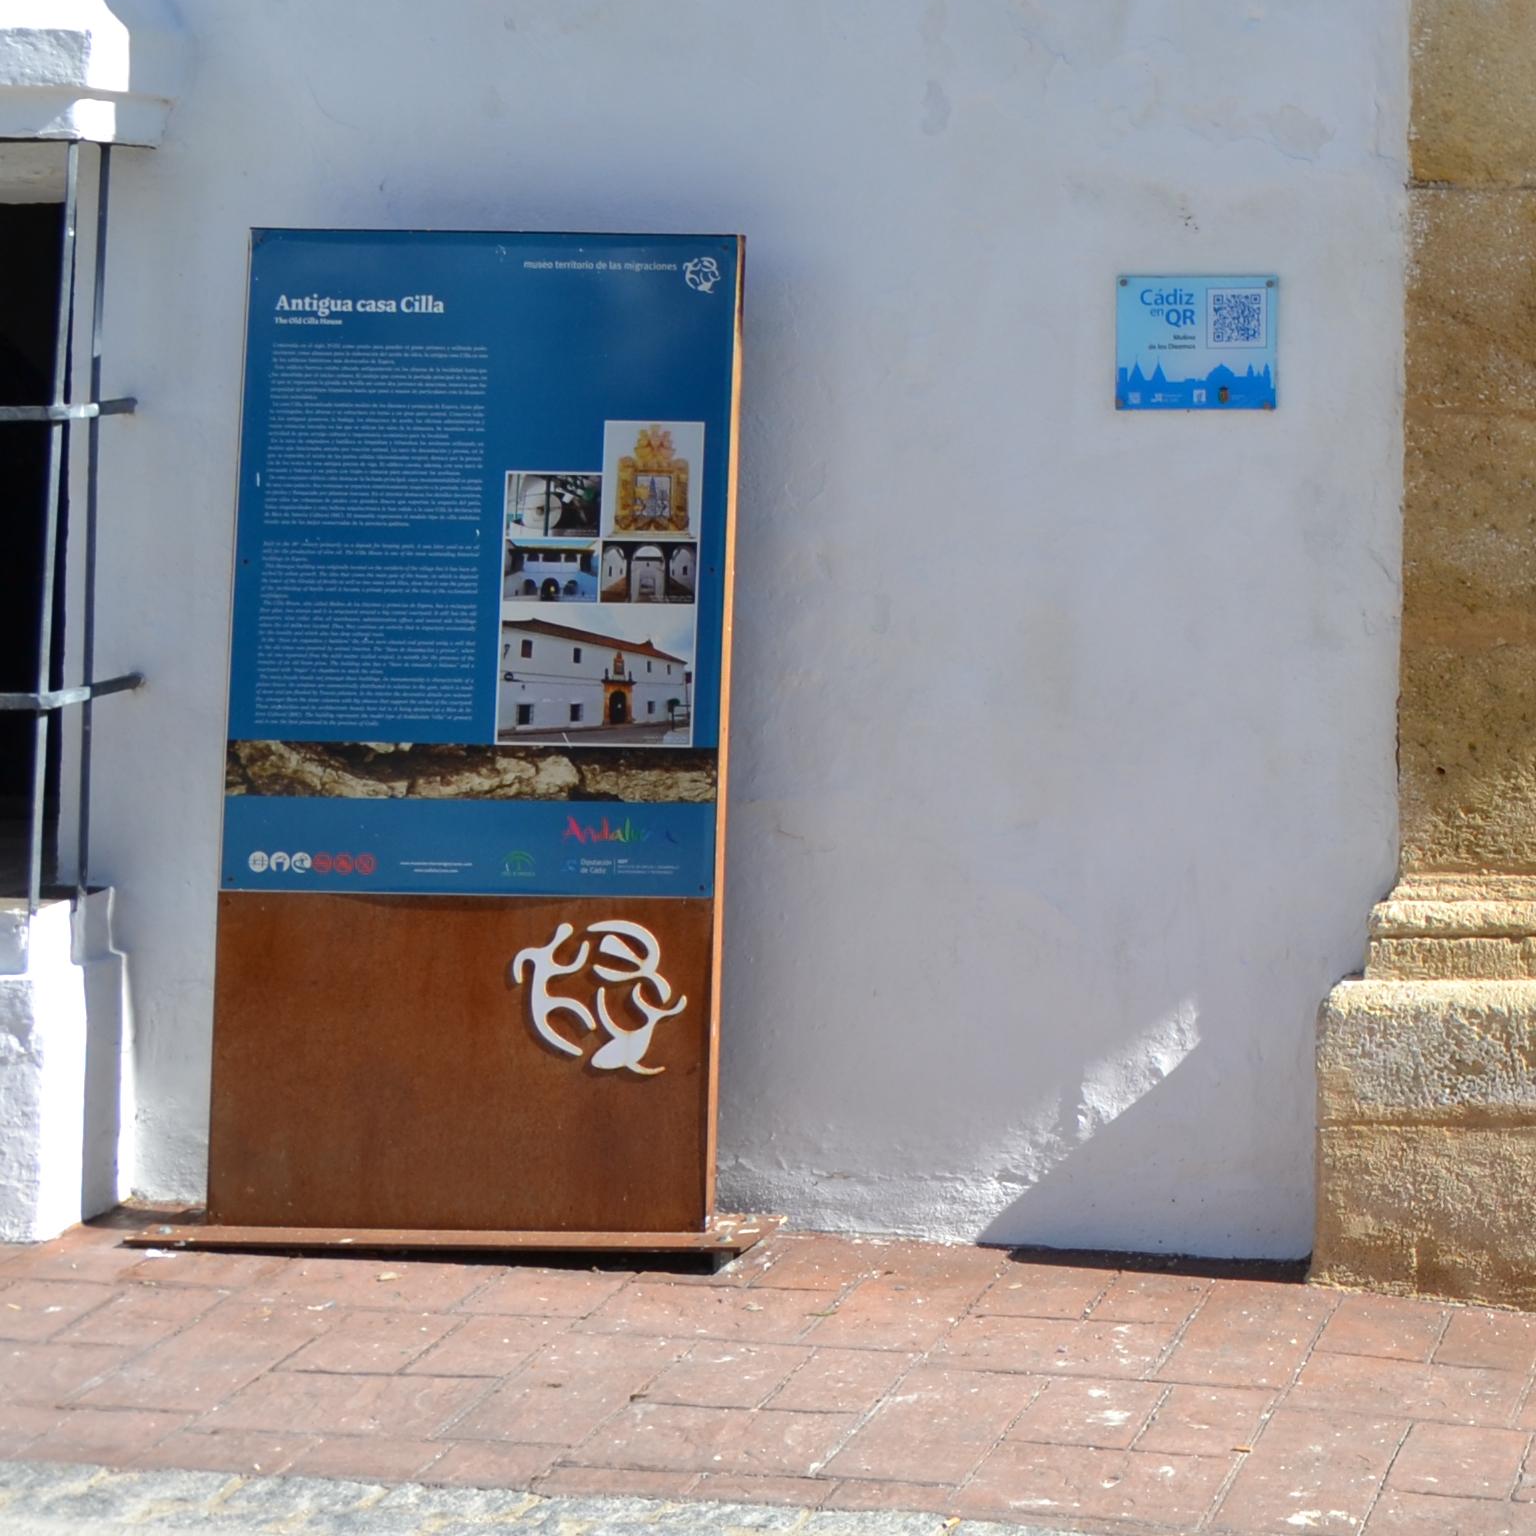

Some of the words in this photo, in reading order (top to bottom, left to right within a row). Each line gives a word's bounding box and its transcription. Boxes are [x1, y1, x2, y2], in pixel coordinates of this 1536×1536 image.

[555, 260, 594, 269] territorio
[596, 260, 607, 270] de
[609, 261, 622, 271] las
[624, 262, 677, 272] migraciones
[275, 293, 353, 317] Antigua
[356, 299, 397, 313] casa
[400, 295, 444, 313] Cilla
[1140, 288, 1194, 306] Cádiz
[1150, 308, 1165, 317] en
[1165, 308, 1196, 327] QR
